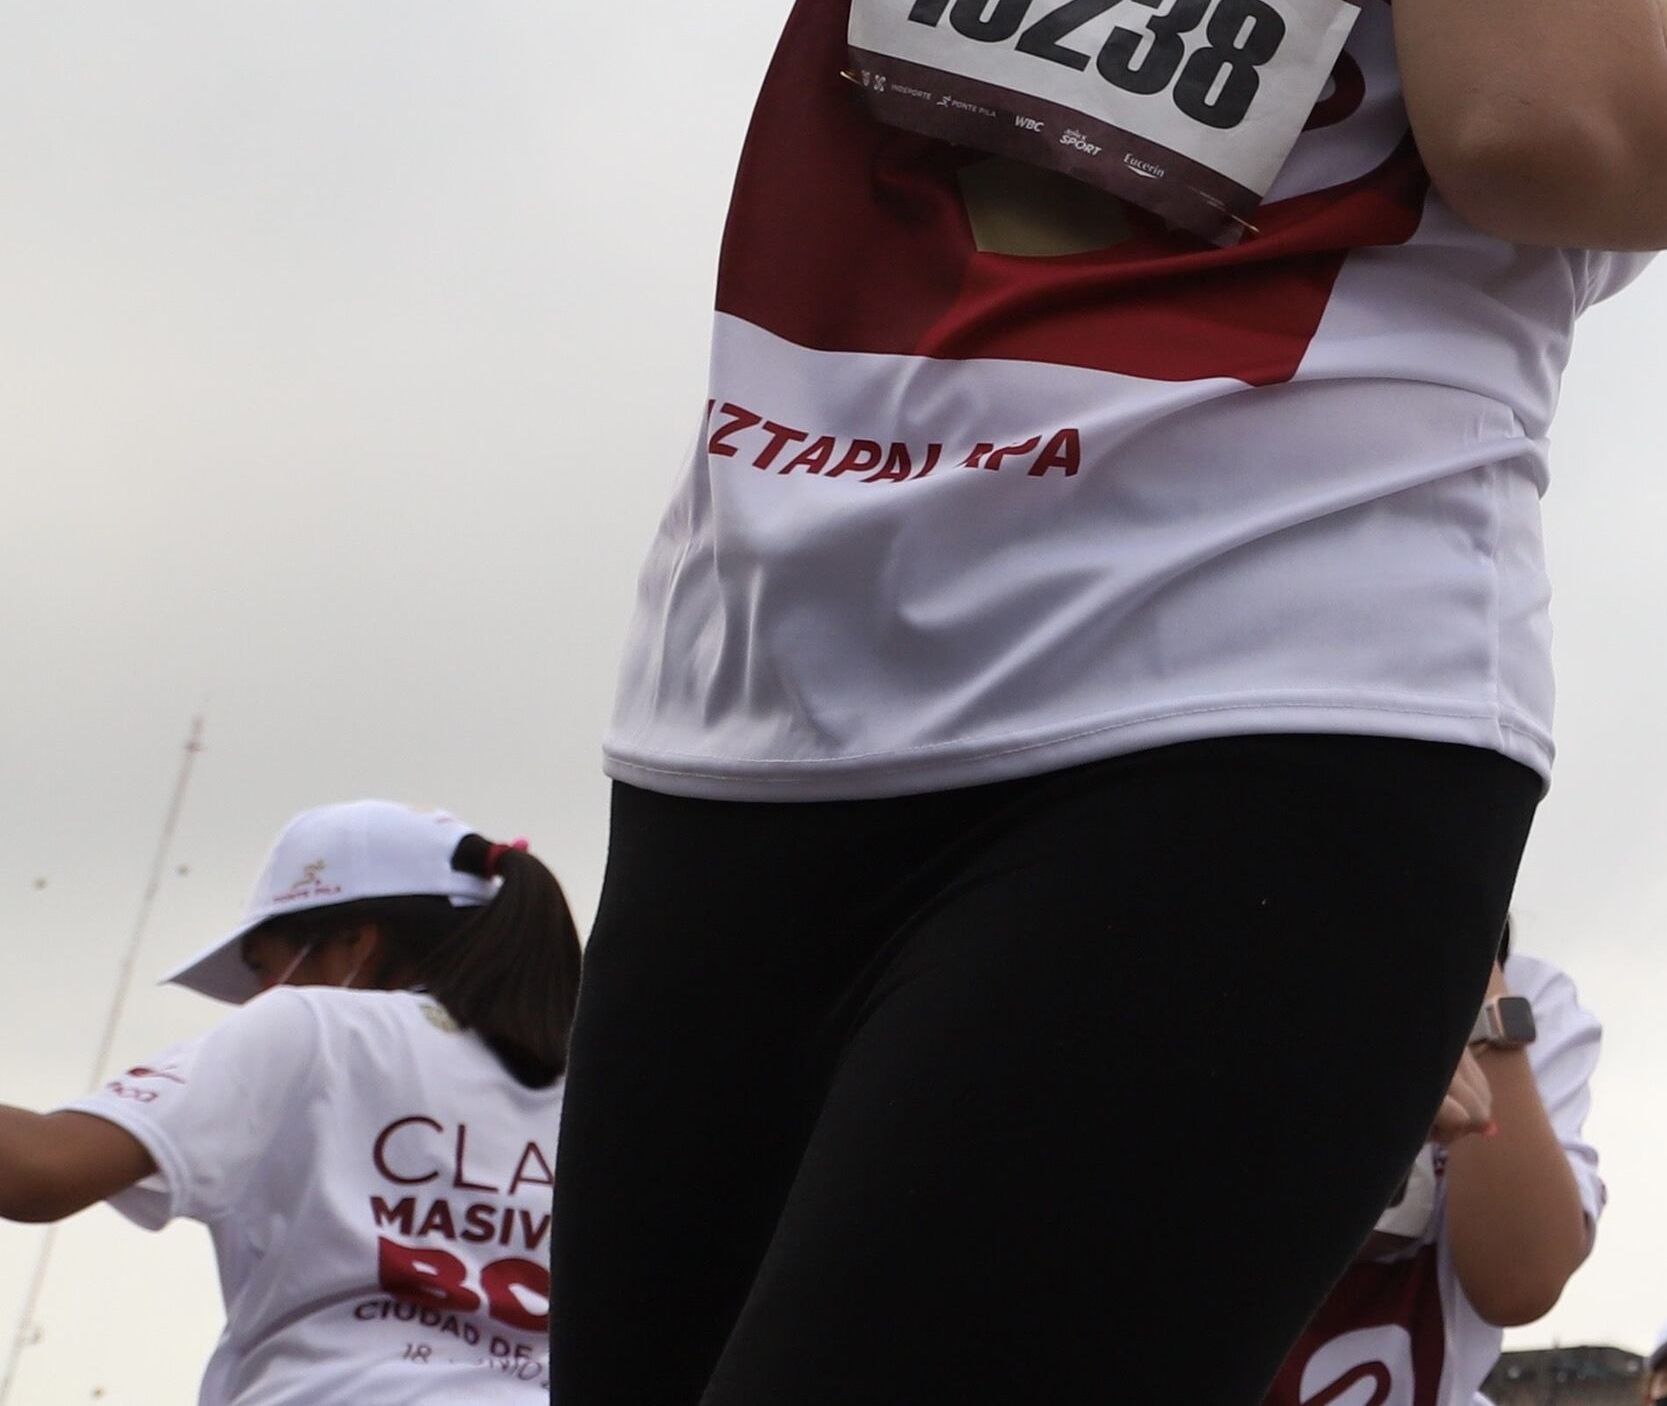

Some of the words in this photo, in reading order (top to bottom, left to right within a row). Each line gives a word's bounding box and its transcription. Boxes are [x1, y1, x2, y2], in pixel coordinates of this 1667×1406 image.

[1014, 115, 1045, 132] WBC
[1059, 134, 1102, 156] SPORT
[1123, 152, 1165, 178] Eucerin
[707, 399, 1082, 484] ZTAPAA
[373, 1116, 554, 1196] CLA
[370, 1196, 550, 1250] MASIV
[378, 1235, 550, 1332] BO
[354, 1300, 480, 1346] CIUDAD
